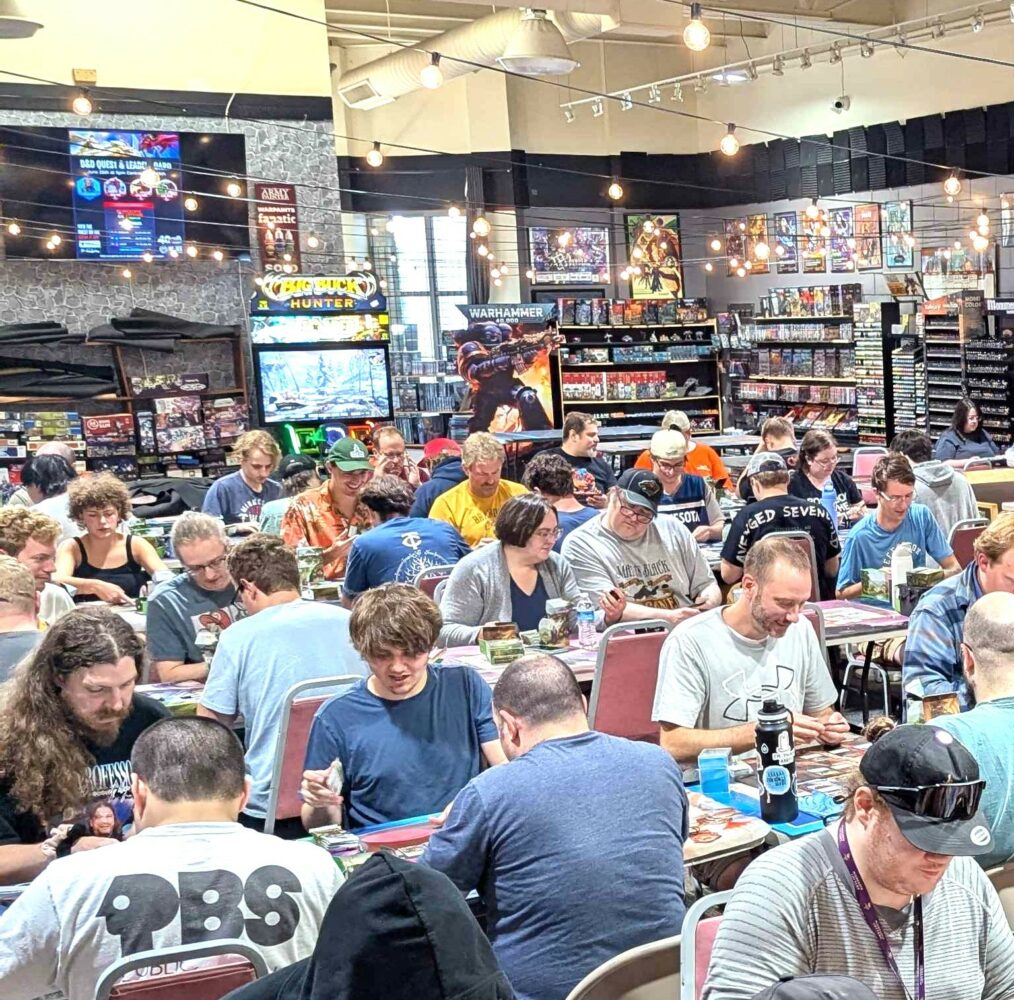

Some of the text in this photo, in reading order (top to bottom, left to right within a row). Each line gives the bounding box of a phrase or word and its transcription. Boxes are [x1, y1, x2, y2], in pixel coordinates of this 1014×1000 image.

[96, 160, 117, 169] QUEST
[258, 213, 296, 224] fanatic
[281, 278, 358, 294] BIG BUCK
[290, 298, 354, 309] HUNTER
[469, 308, 543, 318] WARHAMMER
[643, 560, 670, 577] BLACK
[85, 759, 132, 791] ROFESSO
[95, 865, 303, 957] PBS
[134, 961, 199, 979] UBLIC
